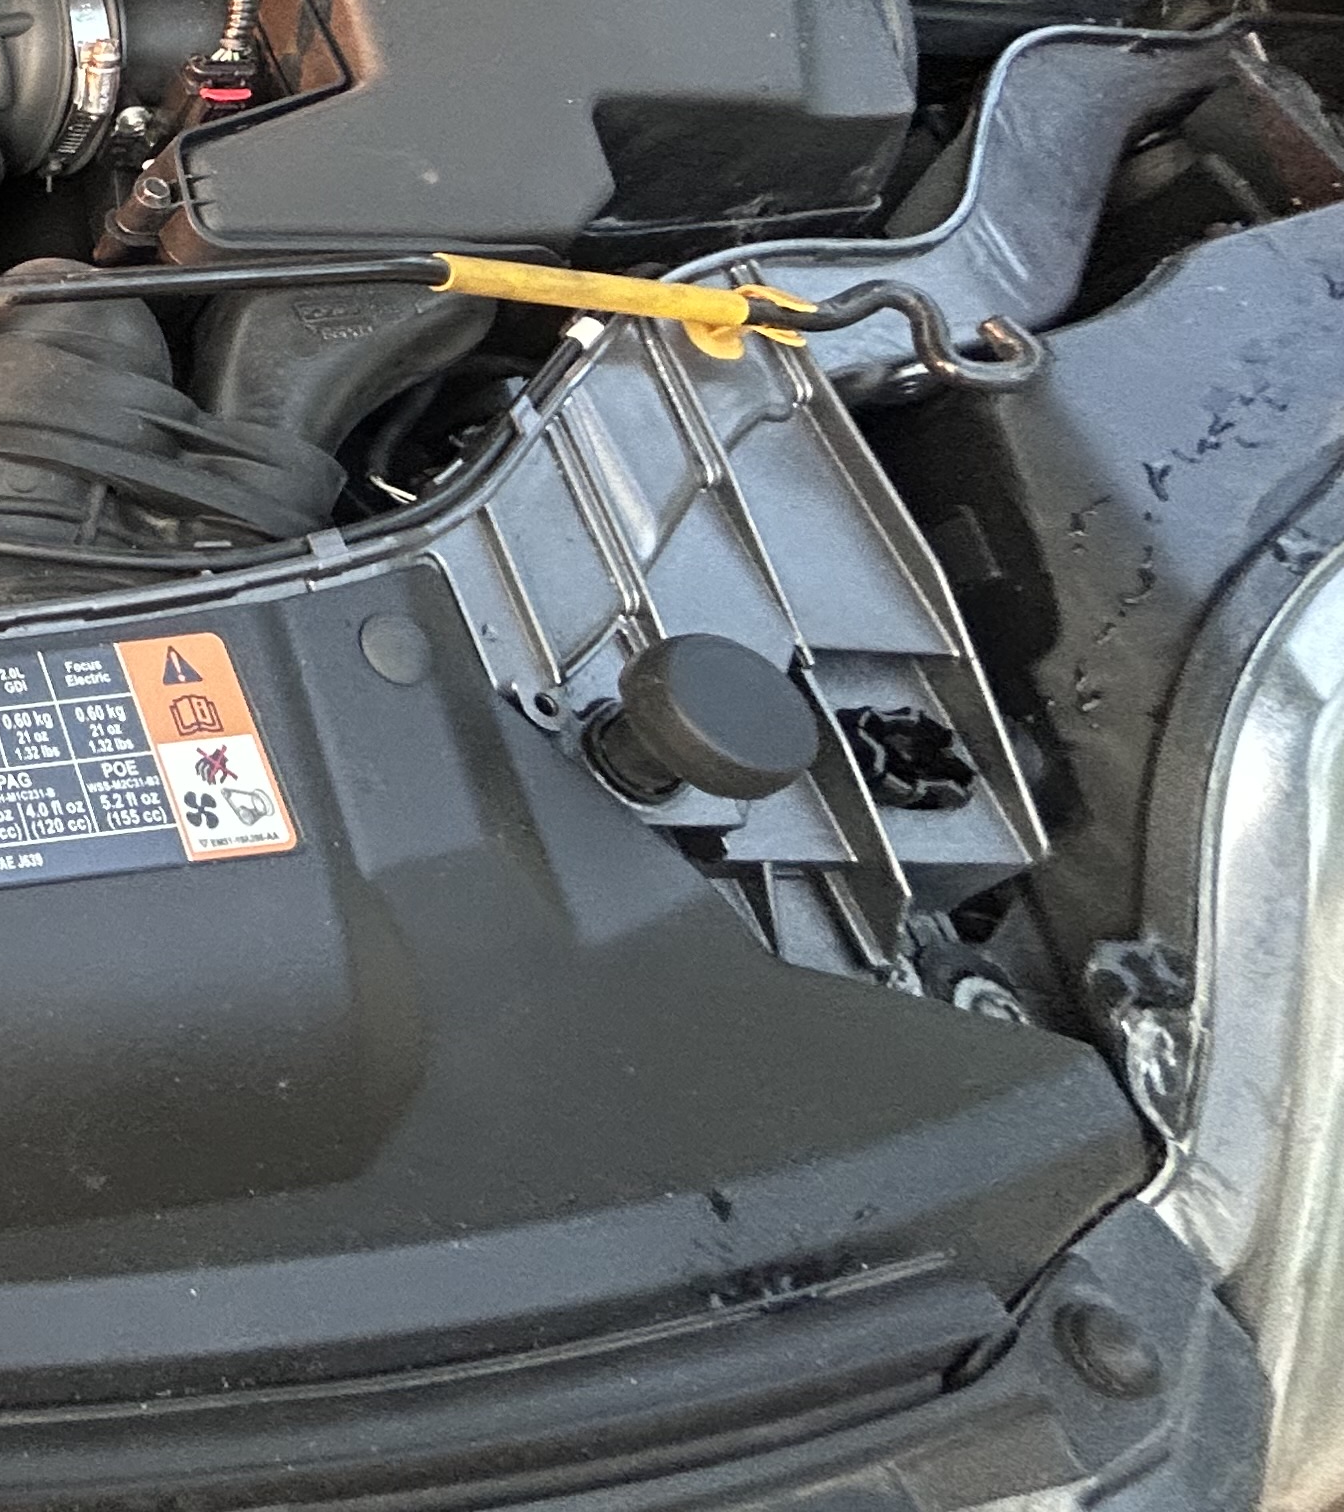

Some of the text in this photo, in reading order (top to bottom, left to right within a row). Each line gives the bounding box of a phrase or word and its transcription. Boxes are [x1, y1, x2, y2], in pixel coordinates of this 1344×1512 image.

[64, 660, 103, 675] Focus
[3, 679, 28, 695] GDI
[65, 671, 111, 688] Electric
[1, 710, 54, 731] 0.60 kg
[73, 701, 127, 723] 0.60 kg
[16, 731, 49, 745] 21 oz
[89, 724, 122, 738] 21 oz
[14, 744, 61, 761] 1.32 lbs
[88, 736, 134, 754] 1.32 lbs
[101, 759, 140, 778] POE
[26, 799, 85, 819] 4.0 fl oz
[100, 791, 161, 811] 5.2 fl oz
[107, 806, 168, 829] (155 cc)
[31, 815, 92, 839] (120 cc)
